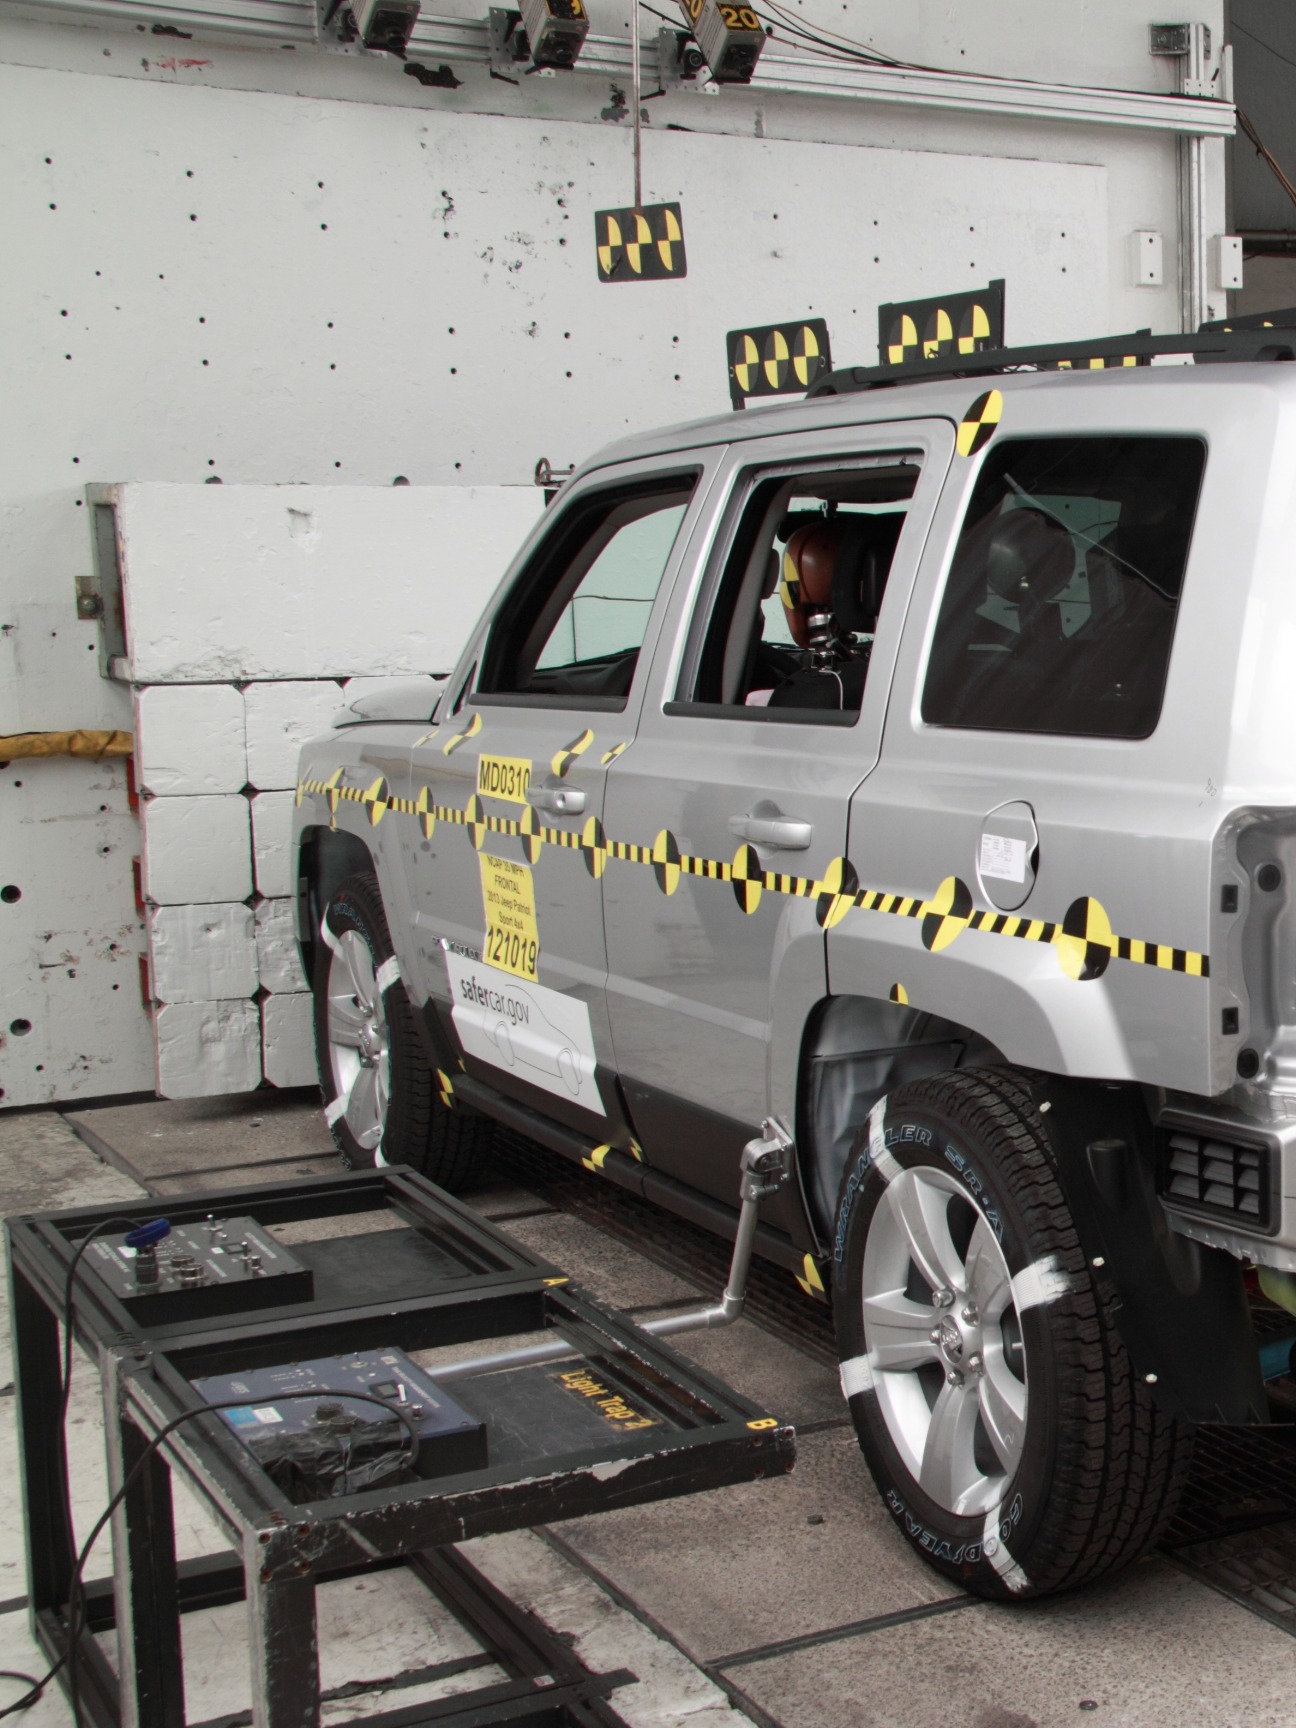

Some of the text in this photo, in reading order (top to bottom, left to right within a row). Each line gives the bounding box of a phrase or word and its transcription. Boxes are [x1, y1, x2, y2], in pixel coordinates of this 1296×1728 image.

[720, 7, 759, 29] 20
[479, 760, 531, 797] MD0310
[494, 875, 521, 895] FRONTAL
[487, 925, 537, 975] 121019
[461, 976, 529, 1026] safercar.gov
[834, 1124, 932, 1262] WRANGLER
[543, 1277, 570, 1286] A
[560, 1369, 609, 1398] Light
[596, 1395, 635, 1420] Trap
[746, 1418, 778, 1430] B
